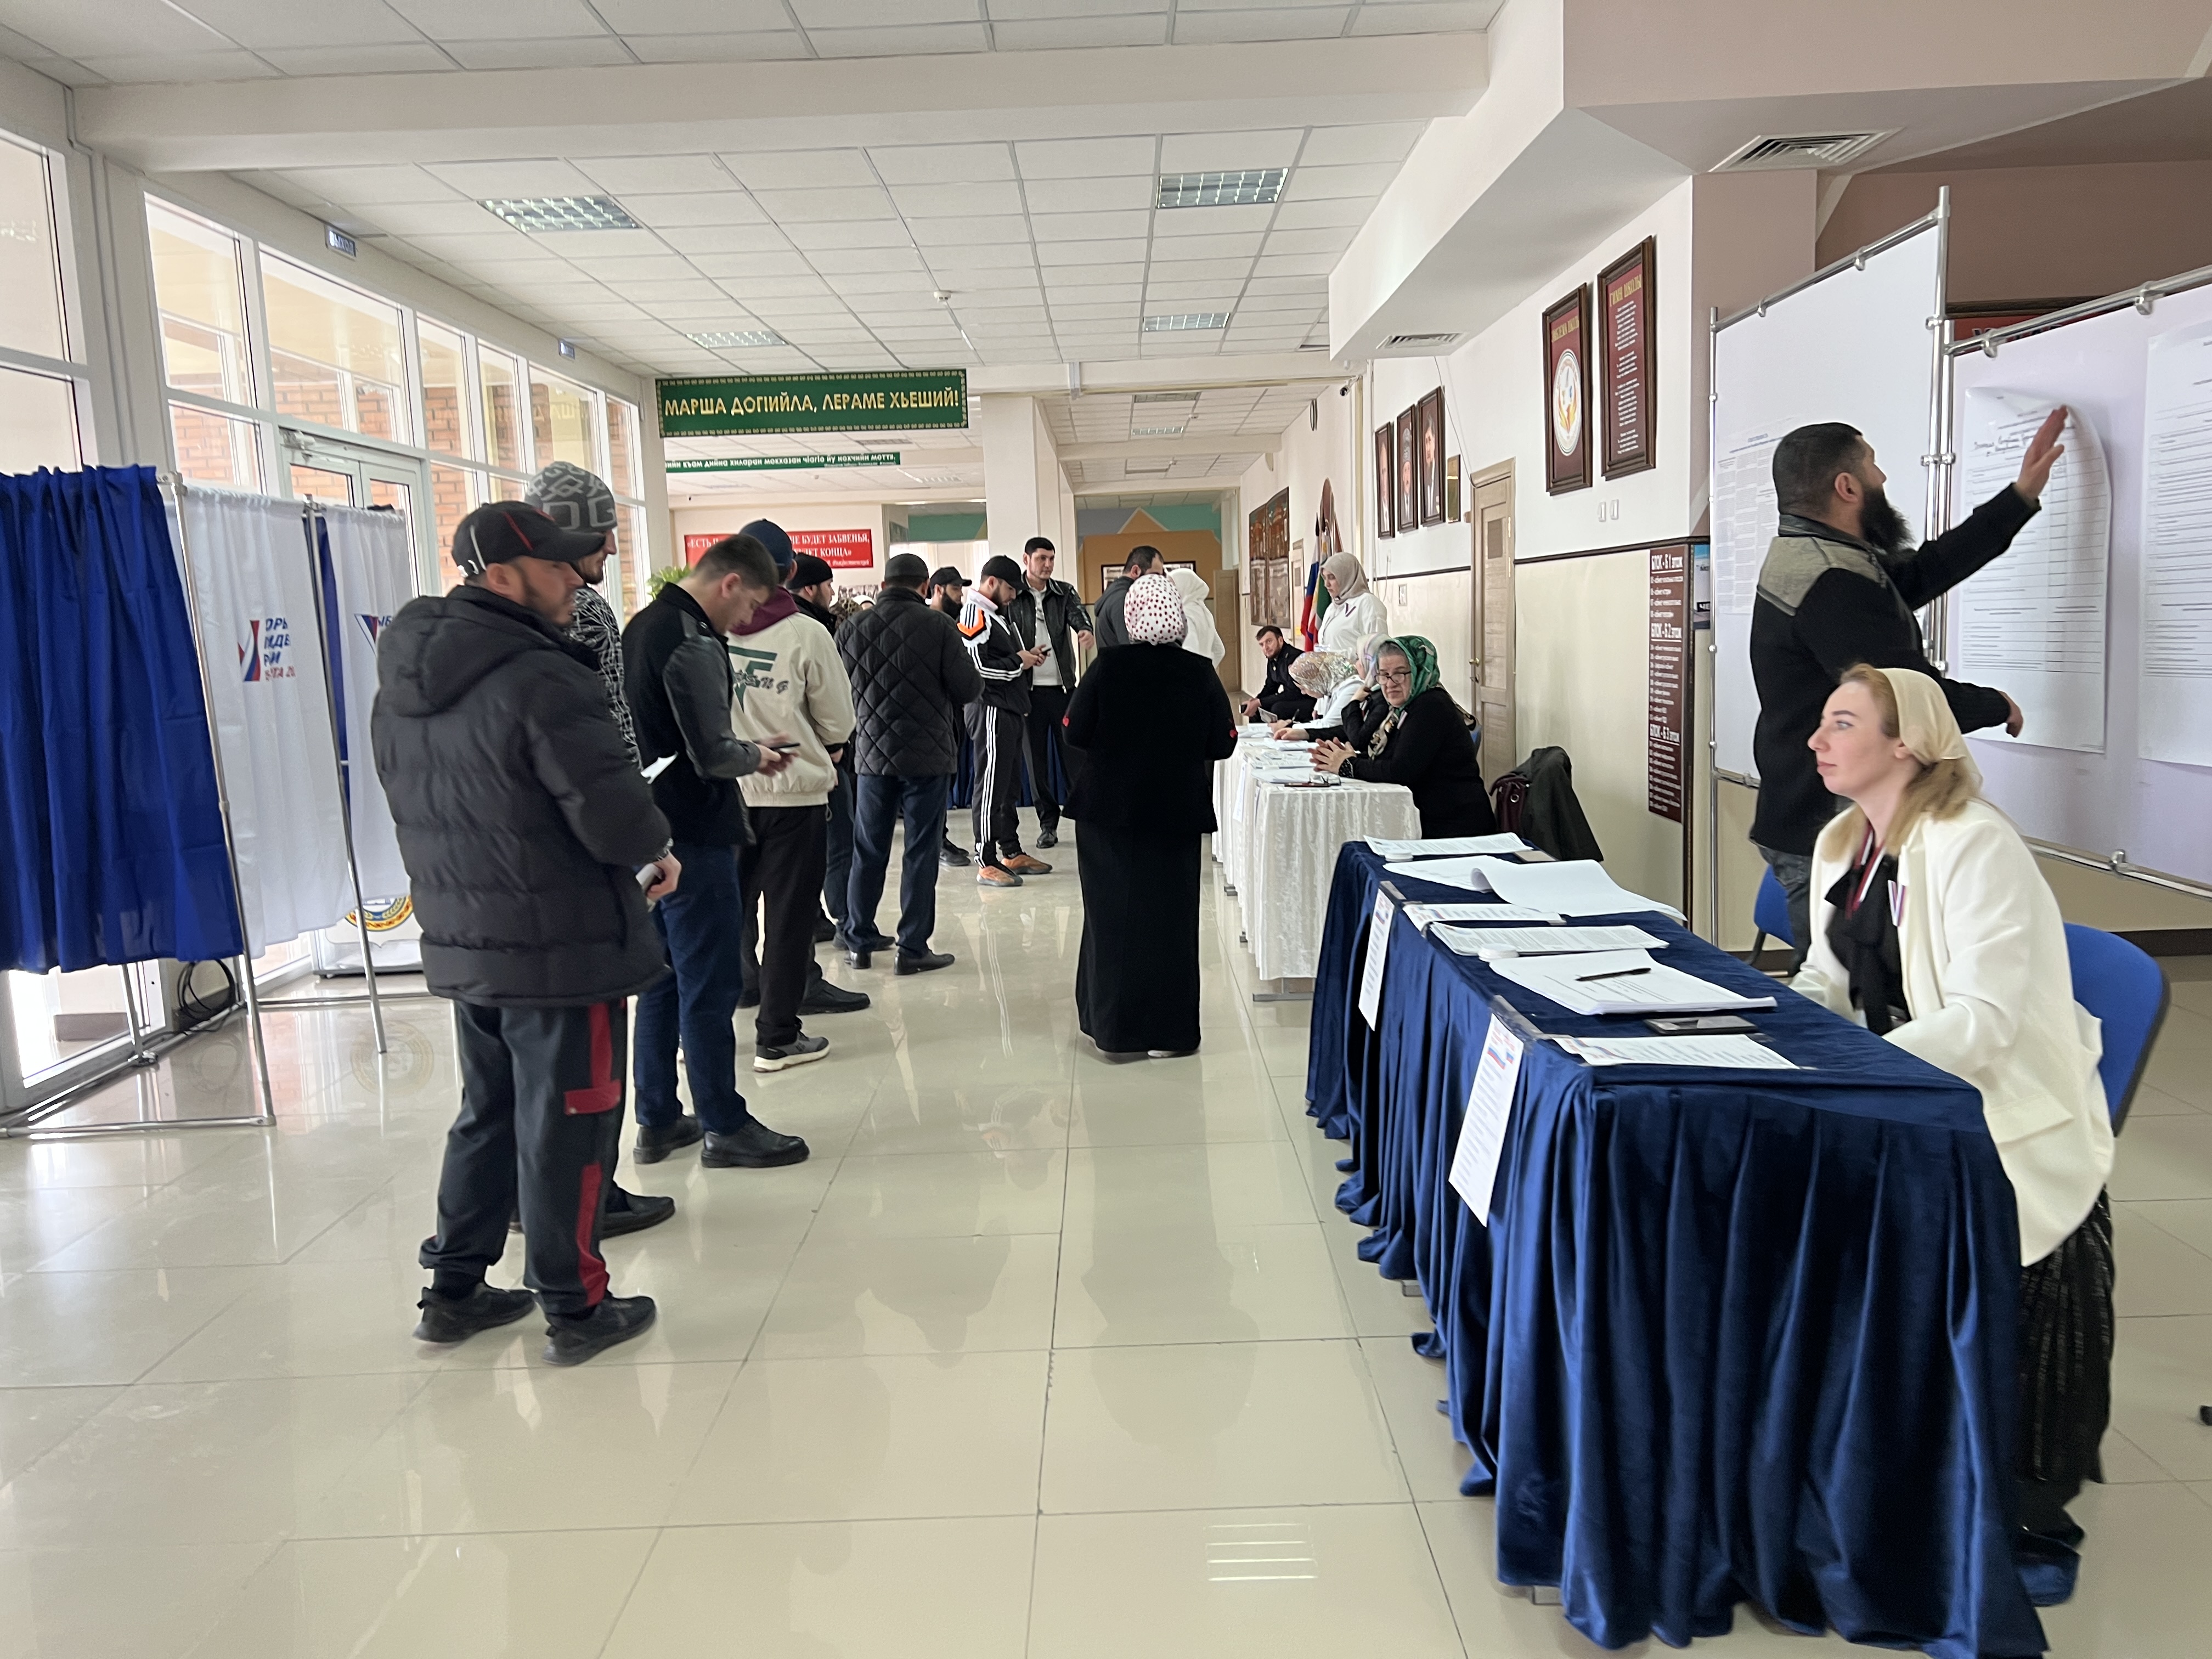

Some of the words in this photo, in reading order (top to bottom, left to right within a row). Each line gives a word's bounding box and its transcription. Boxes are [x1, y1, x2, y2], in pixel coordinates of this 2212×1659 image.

[665, 397, 727, 416] МАРША
[822, 392, 885, 410] ЛЕРАМЕ
[889, 386, 959, 408] ХЬЕШИЙ!
[802, 534, 826, 545] БУДЕТ
[828, 533, 870, 544] ЗАБВЕНЬЯ,
[820, 547, 852, 557] КОНЦА»
